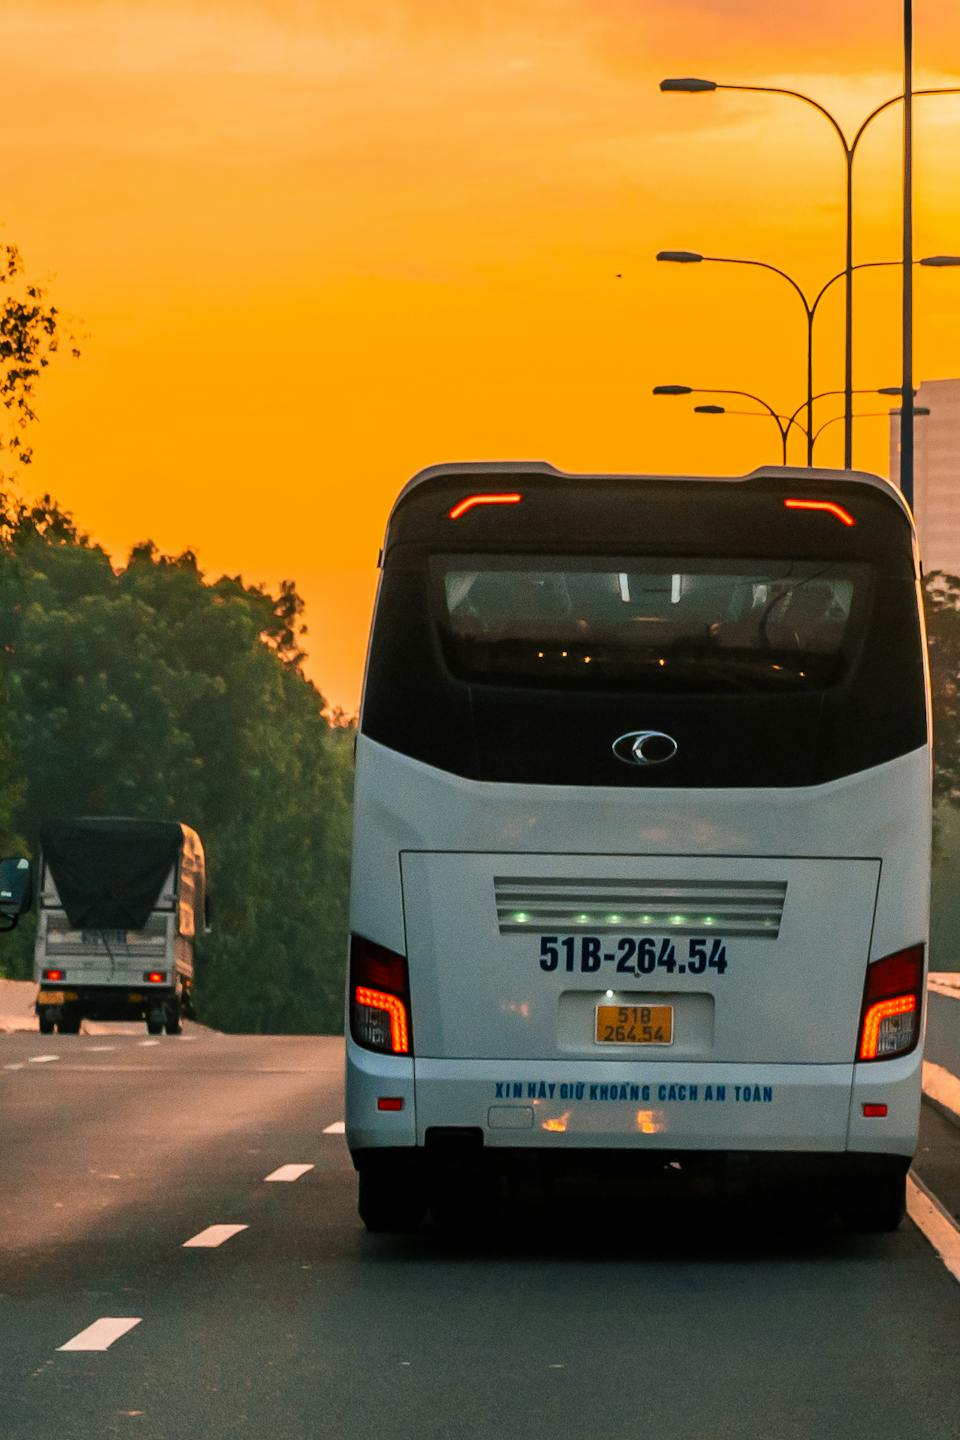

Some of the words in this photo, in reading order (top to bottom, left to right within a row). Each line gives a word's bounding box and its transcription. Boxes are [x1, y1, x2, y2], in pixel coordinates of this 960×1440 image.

[539, 936, 728, 974] 51B-264.54
[618, 1007, 652, 1024] 51B
[604, 1025, 663, 1042] 264.54
[495, 1082, 522, 1099] XIN
[704, 1085, 726, 1101] AN
